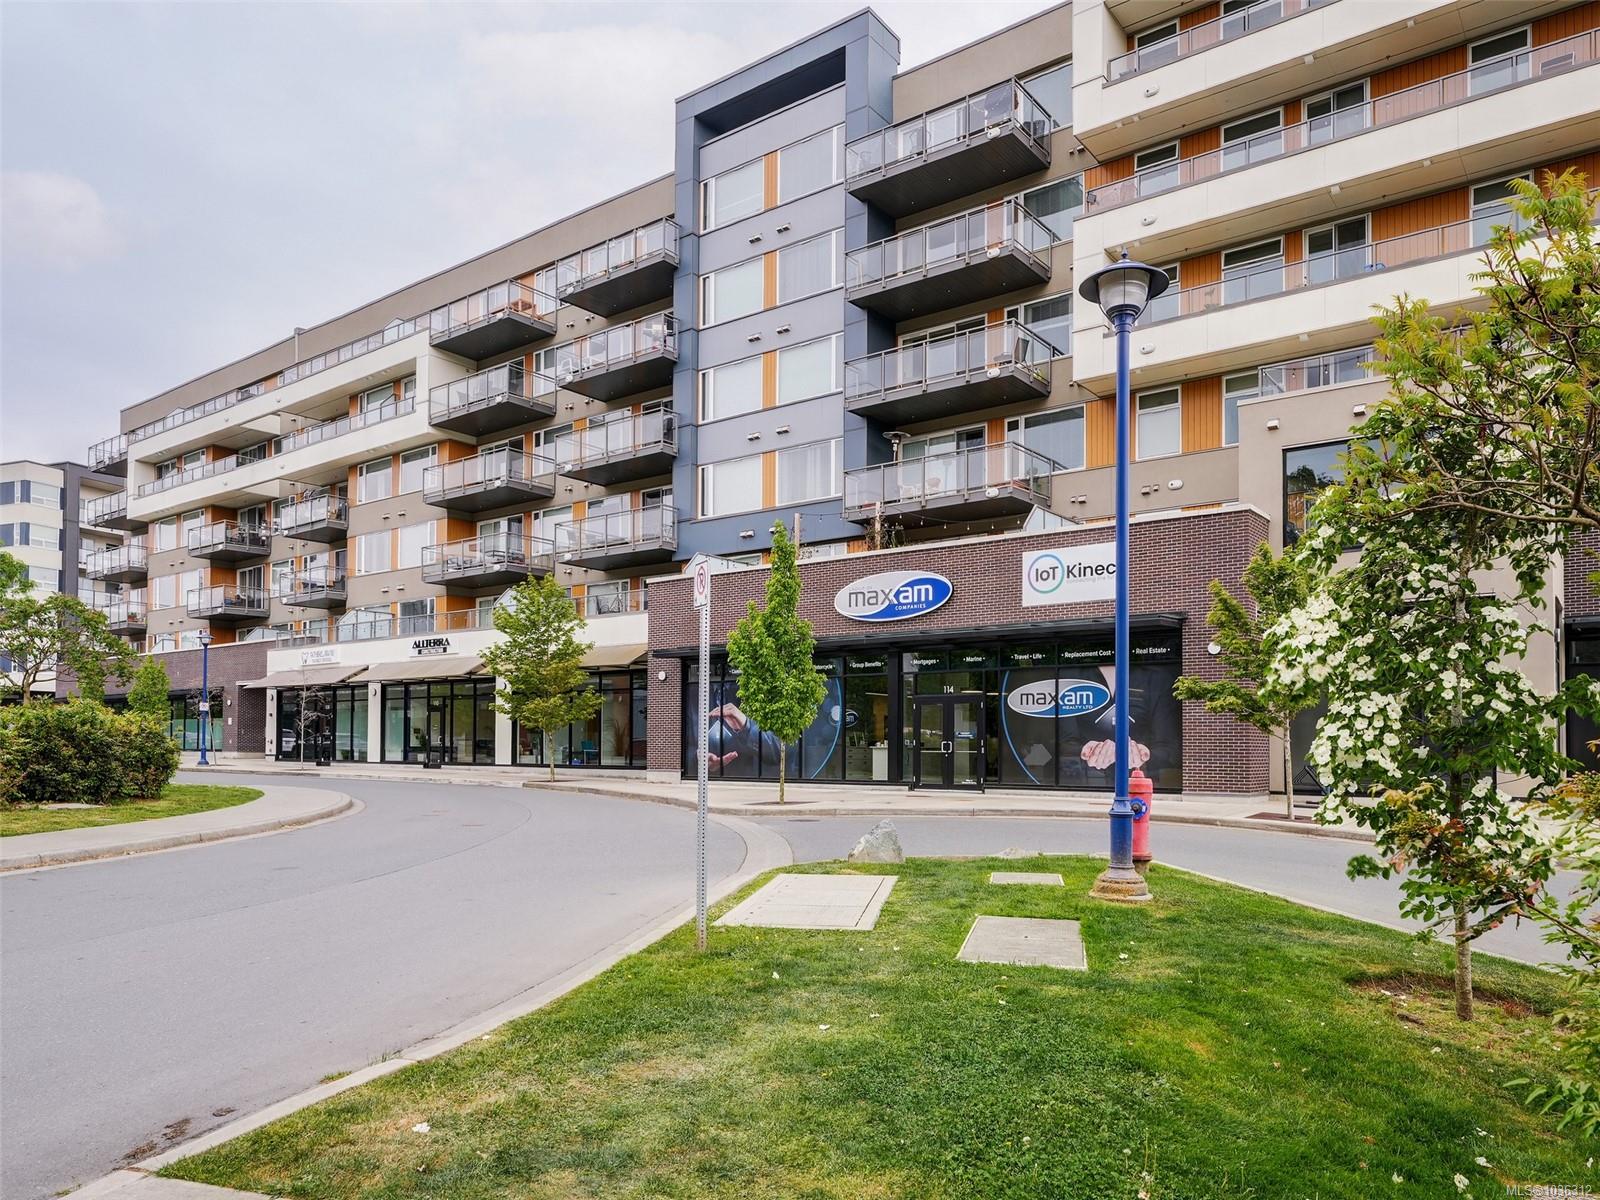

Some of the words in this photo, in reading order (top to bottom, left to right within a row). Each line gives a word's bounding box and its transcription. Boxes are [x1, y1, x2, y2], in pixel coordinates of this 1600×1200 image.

[1035, 566, 1059, 582] IoT
[1066, 562, 1116, 579] Kinec
[895, 603, 926, 611] COMPANIES
[411, 637, 450, 649] ALLTERRA
[1064, 650, 1098, 658] Replacement
[1135, 647, 1148, 655] Real
[913, 658, 936, 666] Mortgages
[943, 685, 954, 694] 114
